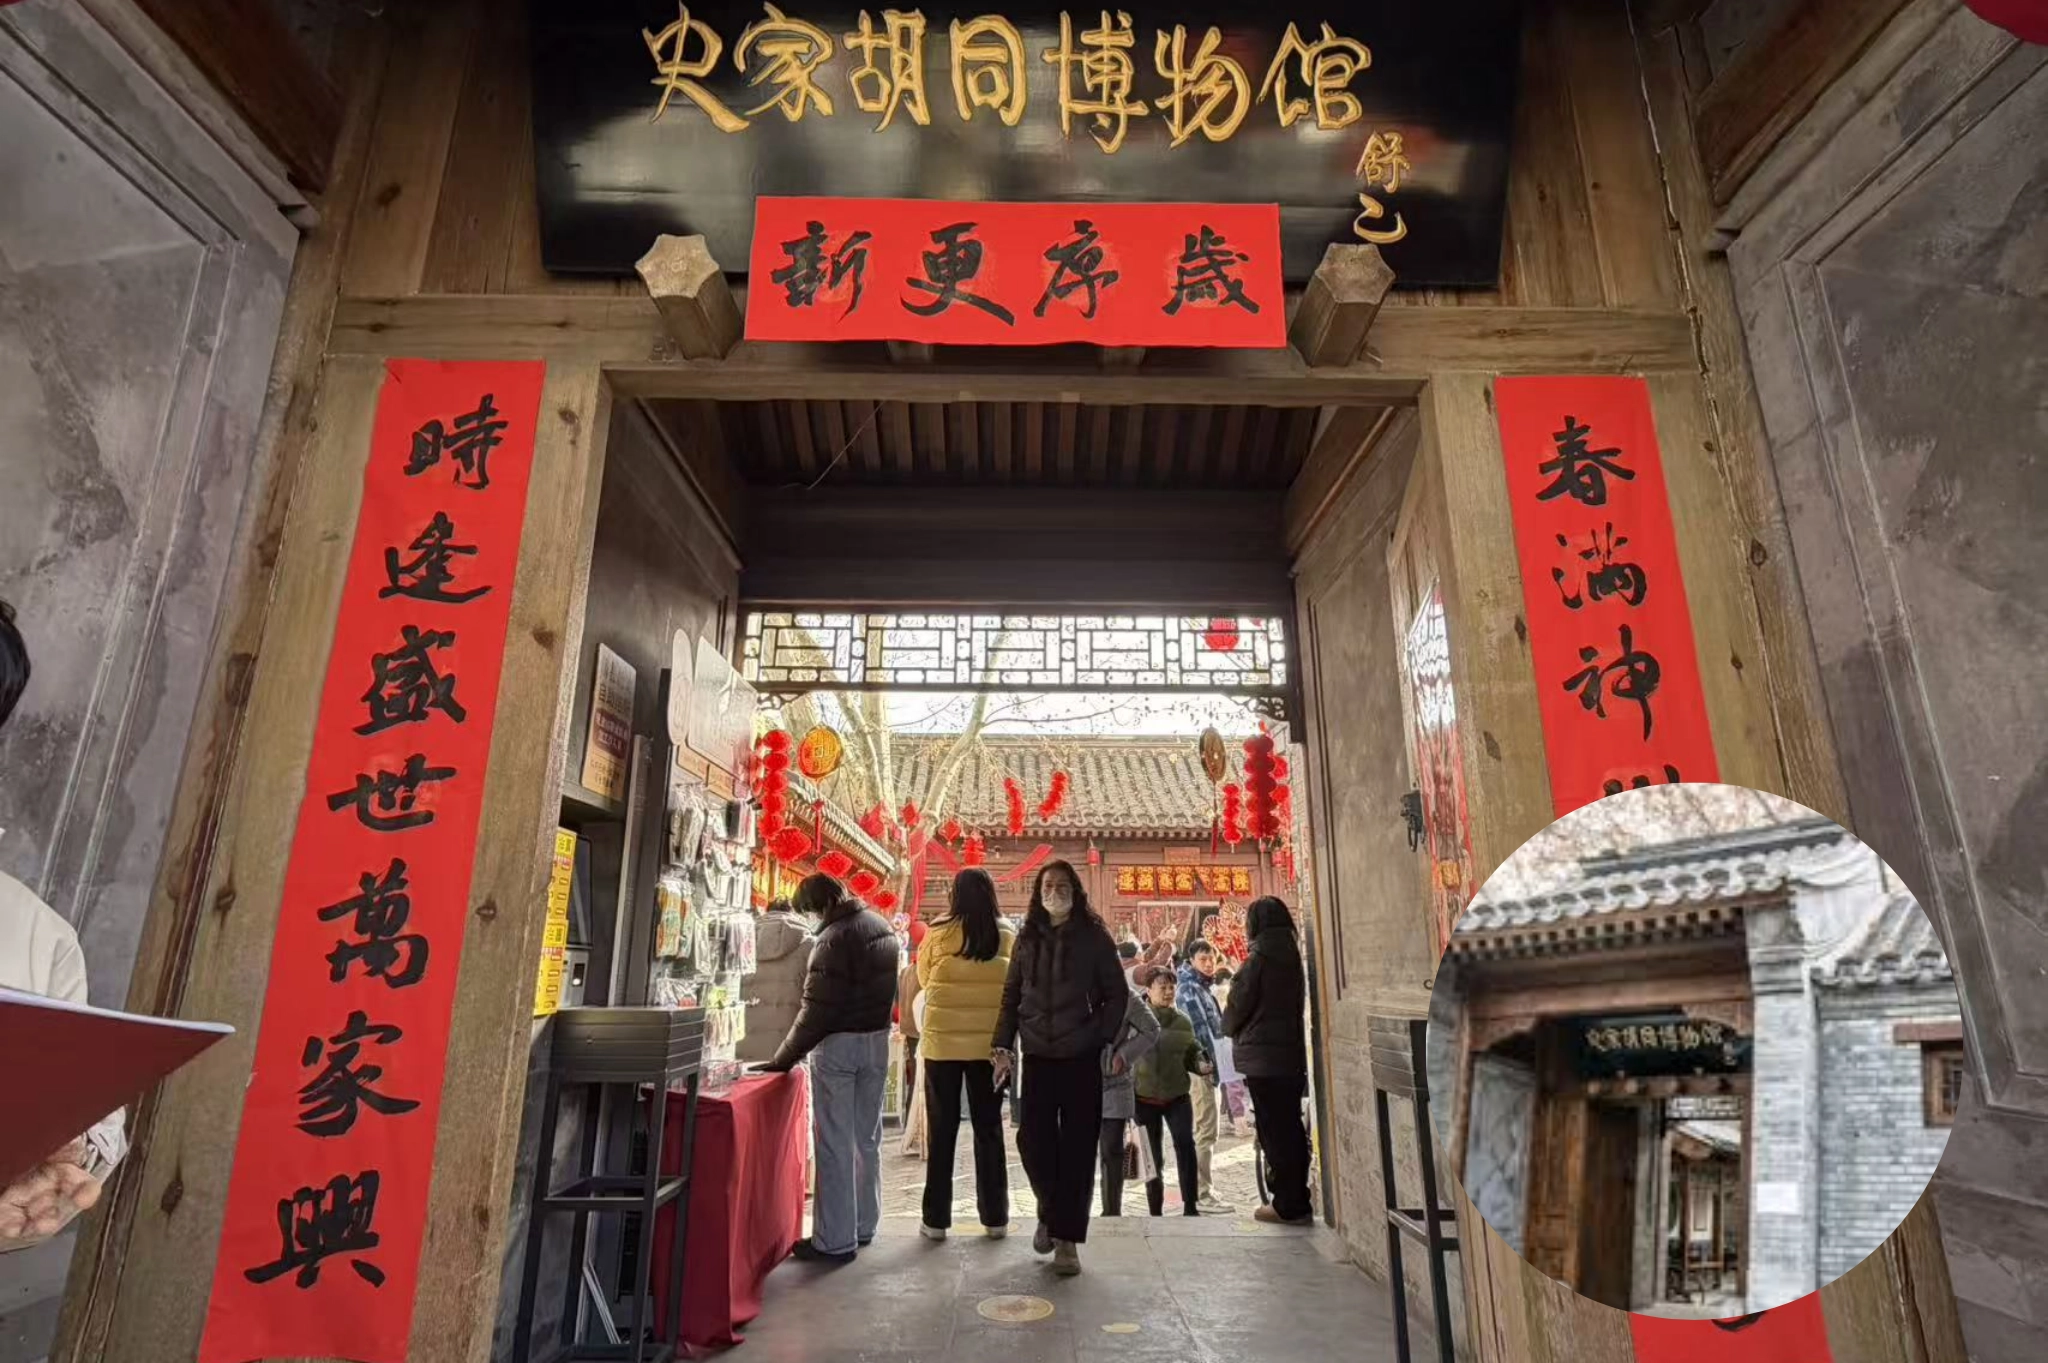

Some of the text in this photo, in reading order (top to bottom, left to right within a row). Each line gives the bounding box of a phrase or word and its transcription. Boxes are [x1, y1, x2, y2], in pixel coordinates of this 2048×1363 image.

[642, 3, 1371, 154] 史家胡同博物馆
